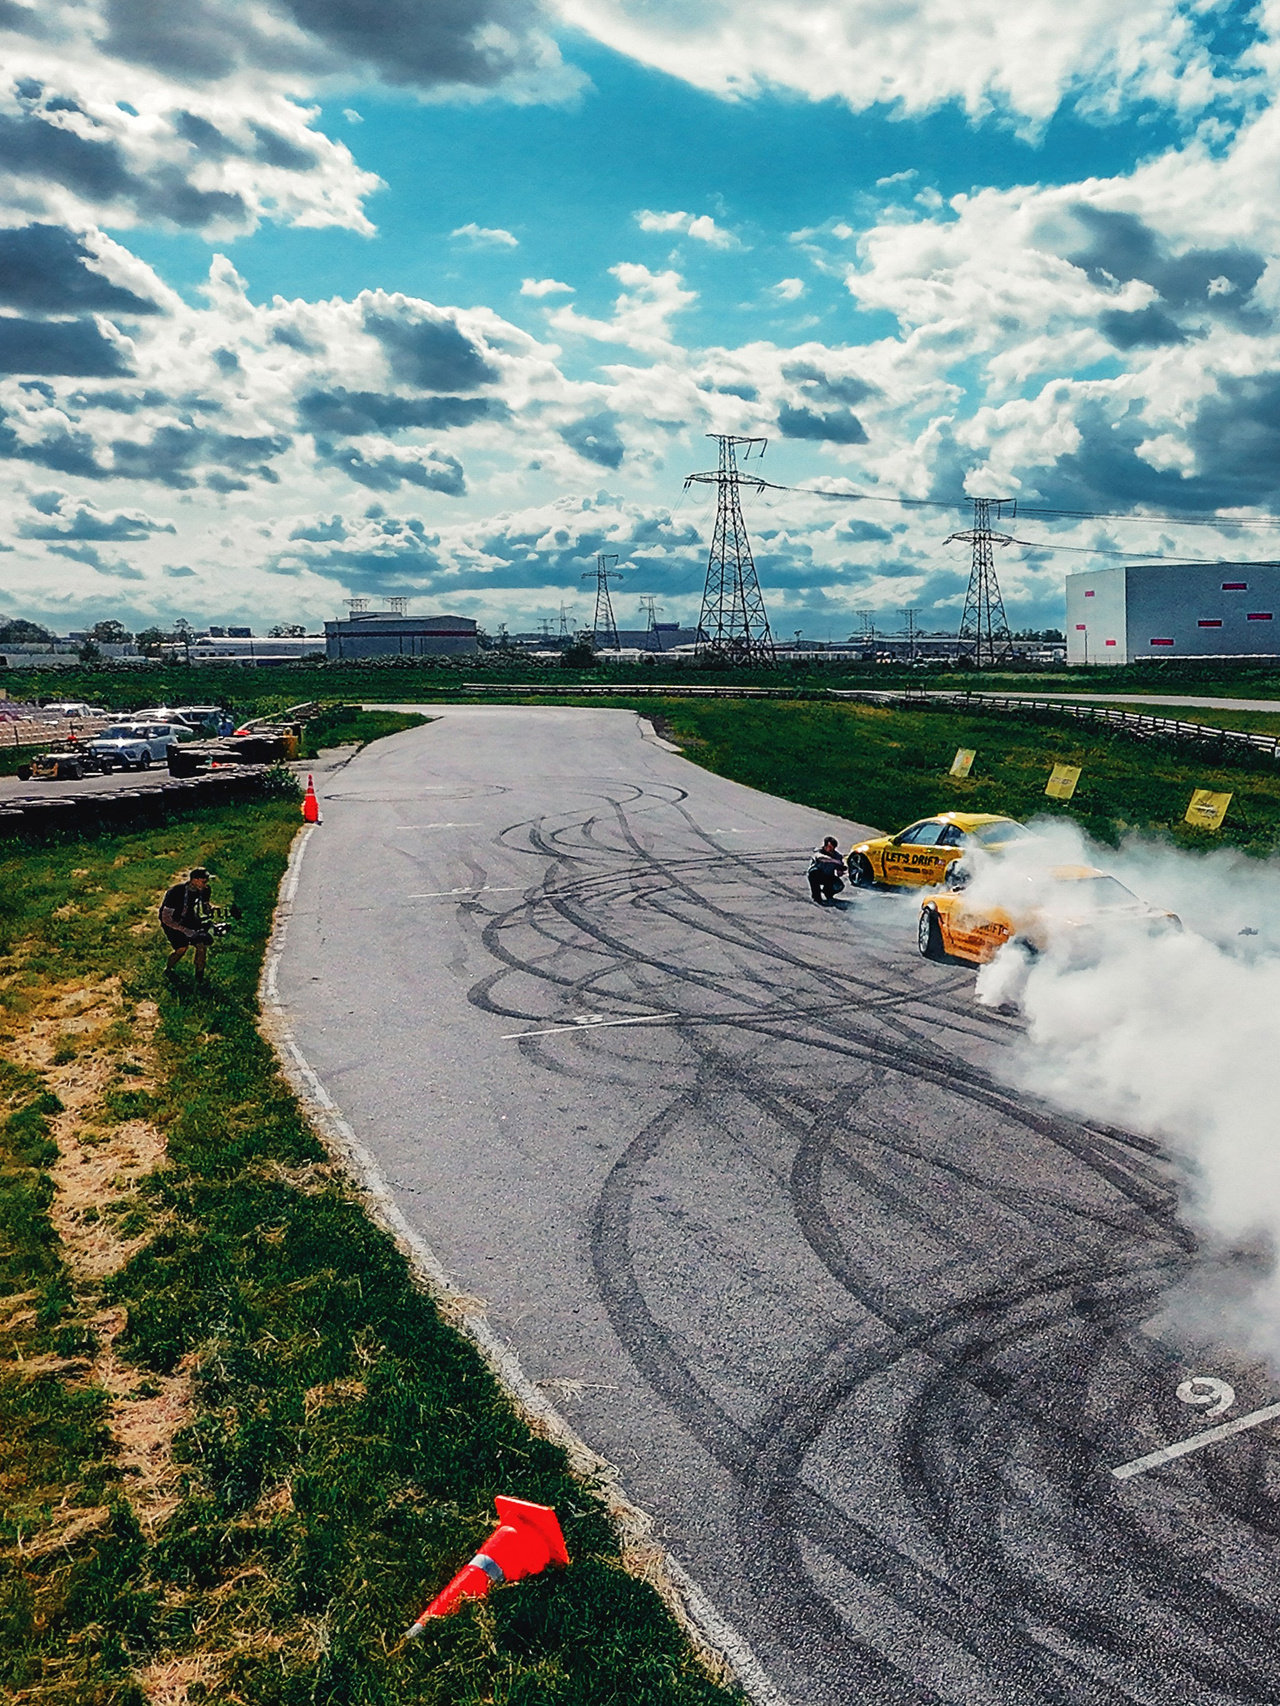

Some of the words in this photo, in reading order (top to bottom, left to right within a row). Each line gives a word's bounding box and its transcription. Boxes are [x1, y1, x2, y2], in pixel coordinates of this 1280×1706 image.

[886, 852, 910, 864] LET'S
[912, 854, 940, 866] DRIFT
[1175, 1376, 1236, 1417] 9
